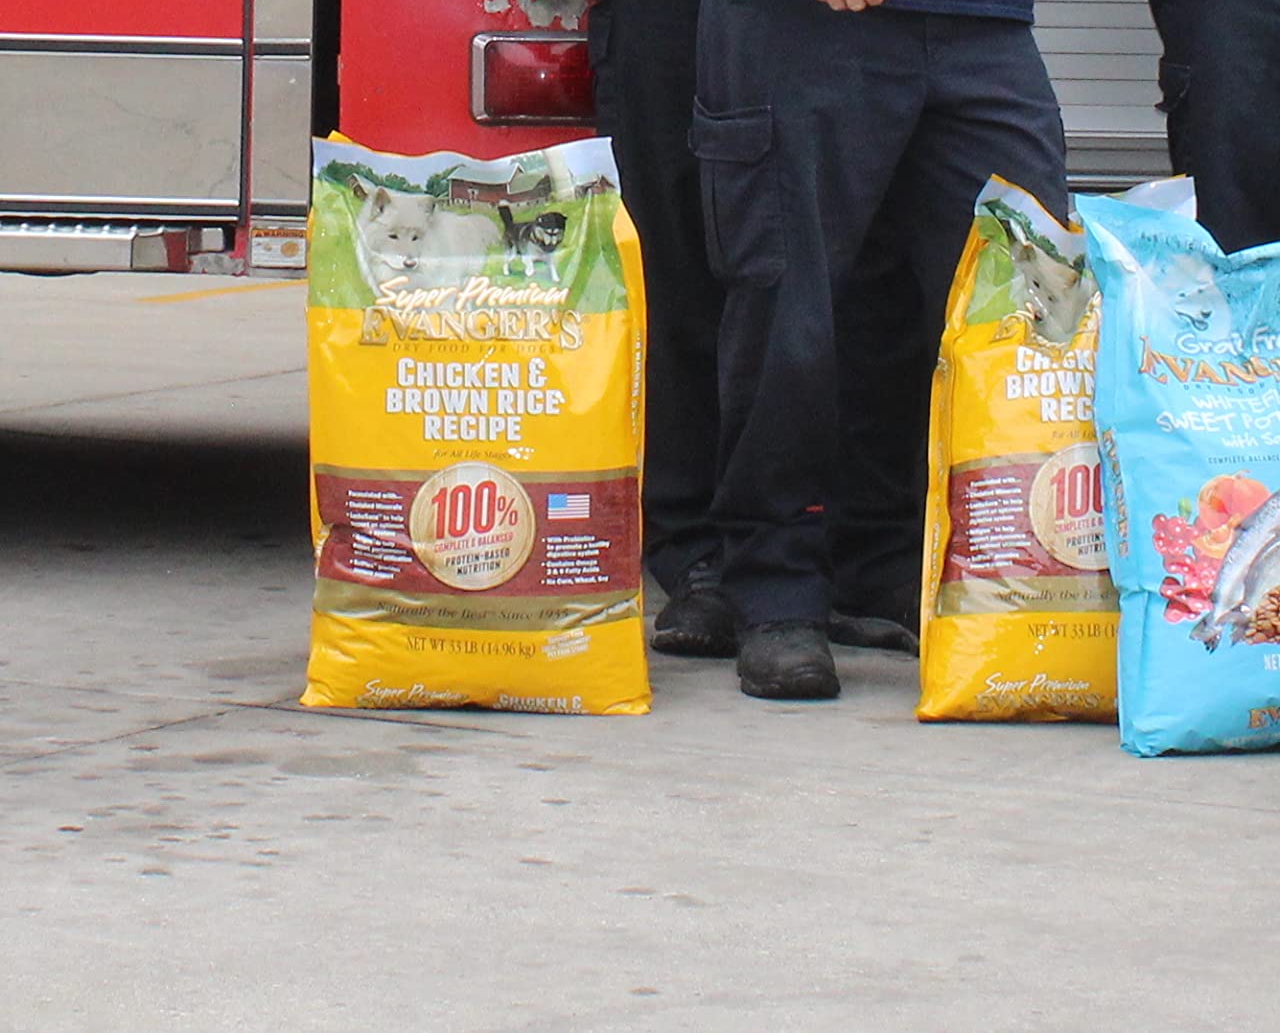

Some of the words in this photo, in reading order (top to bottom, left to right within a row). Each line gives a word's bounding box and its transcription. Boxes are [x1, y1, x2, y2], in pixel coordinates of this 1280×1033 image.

[376, 276, 457, 313] Super
[456, 276, 570, 310] Premium
[358, 306, 585, 350] EVANGER'S
[393, 343, 419, 354] DRY
[428, 343, 470, 354] FOOD
[1175, 332, 1244, 358] Grai
[1017, 346, 1095, 372] CHCK
[528, 357, 548, 388] &
[386, 387, 489, 414] BROWN
[497, 389, 563, 415] RICE
[1041, 396, 1093, 422] REC
[424, 415, 523, 441] RECIPE
[1156, 410, 1237, 434] SWEET
[1221, 433, 1259, 449] with
[1207, 456, 1246, 465] COMPLETE
[431, 480, 518, 540] 100%
[434, 540, 471, 554] COMPLETE
[477, 532, 514, 546] BALANCED
[456, 561, 501, 575] NUTRITION
[376, 601, 434, 617] Naturally
[437, 604, 457, 617] the
[499, 610, 535, 621] Since
[1027, 623, 1048, 638] NET
[1071, 624, 1083, 639] 33
[1087, 623, 1101, 638] LB
[405, 636, 428, 650] NET
[430, 637, 446, 651] WT
[450, 639, 462, 654] 33
[464, 641, 478, 654] LB
[518, 641, 537, 659] kg)
[365, 679, 405, 701] Super
[985, 672, 1028, 695] Super
[1028, 673, 1090, 693] Premium
